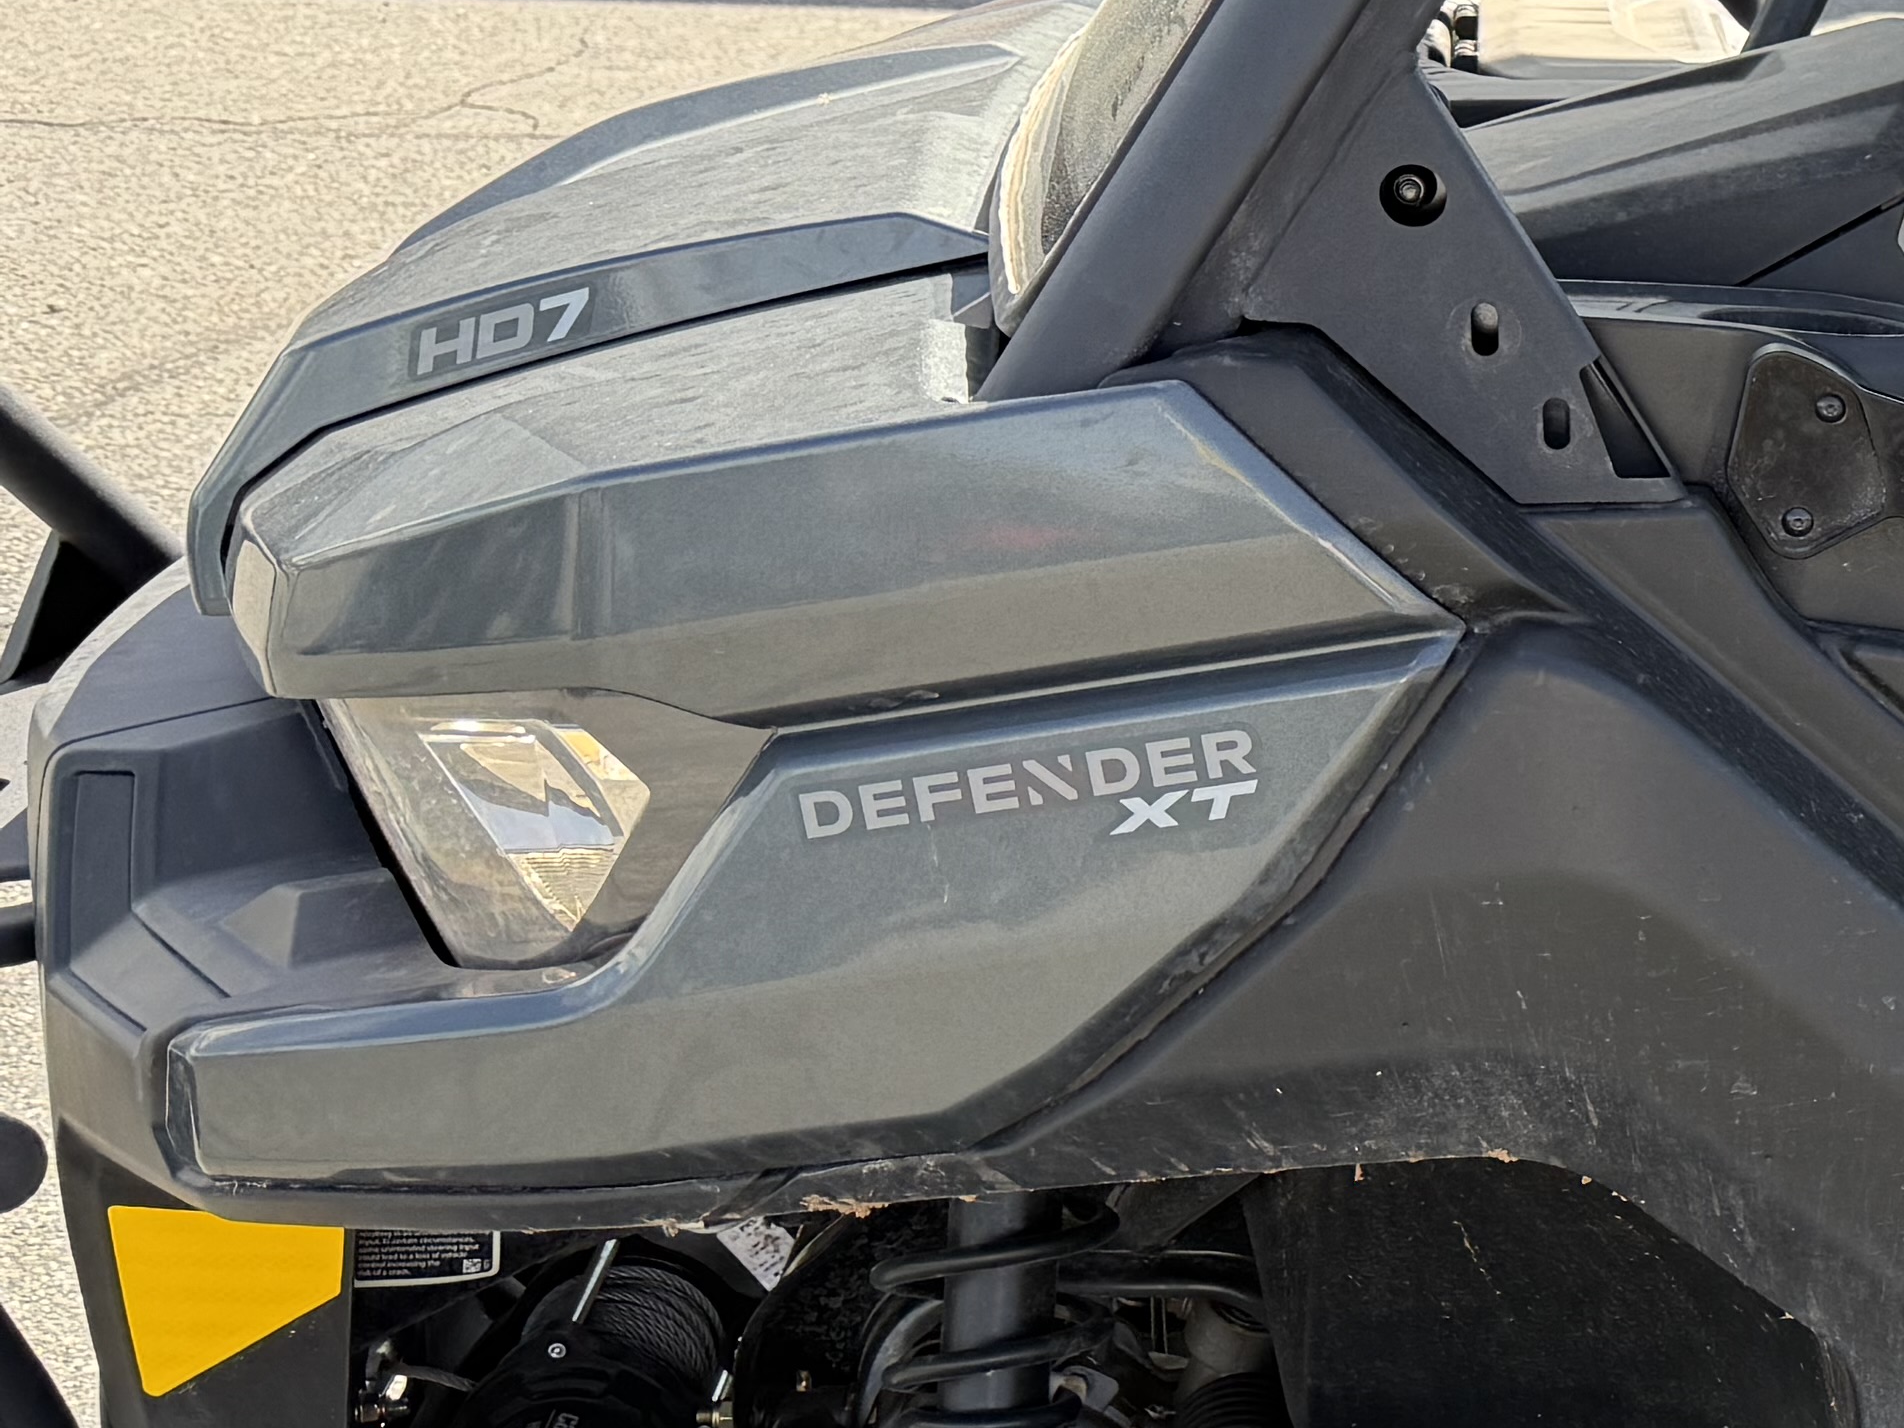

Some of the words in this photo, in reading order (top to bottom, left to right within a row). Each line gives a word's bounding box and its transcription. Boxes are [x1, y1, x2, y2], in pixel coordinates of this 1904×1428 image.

[416, 286, 591, 377] HD7
[798, 729, 1258, 839] DEFENDER
[1109, 778, 1259, 836] XT
